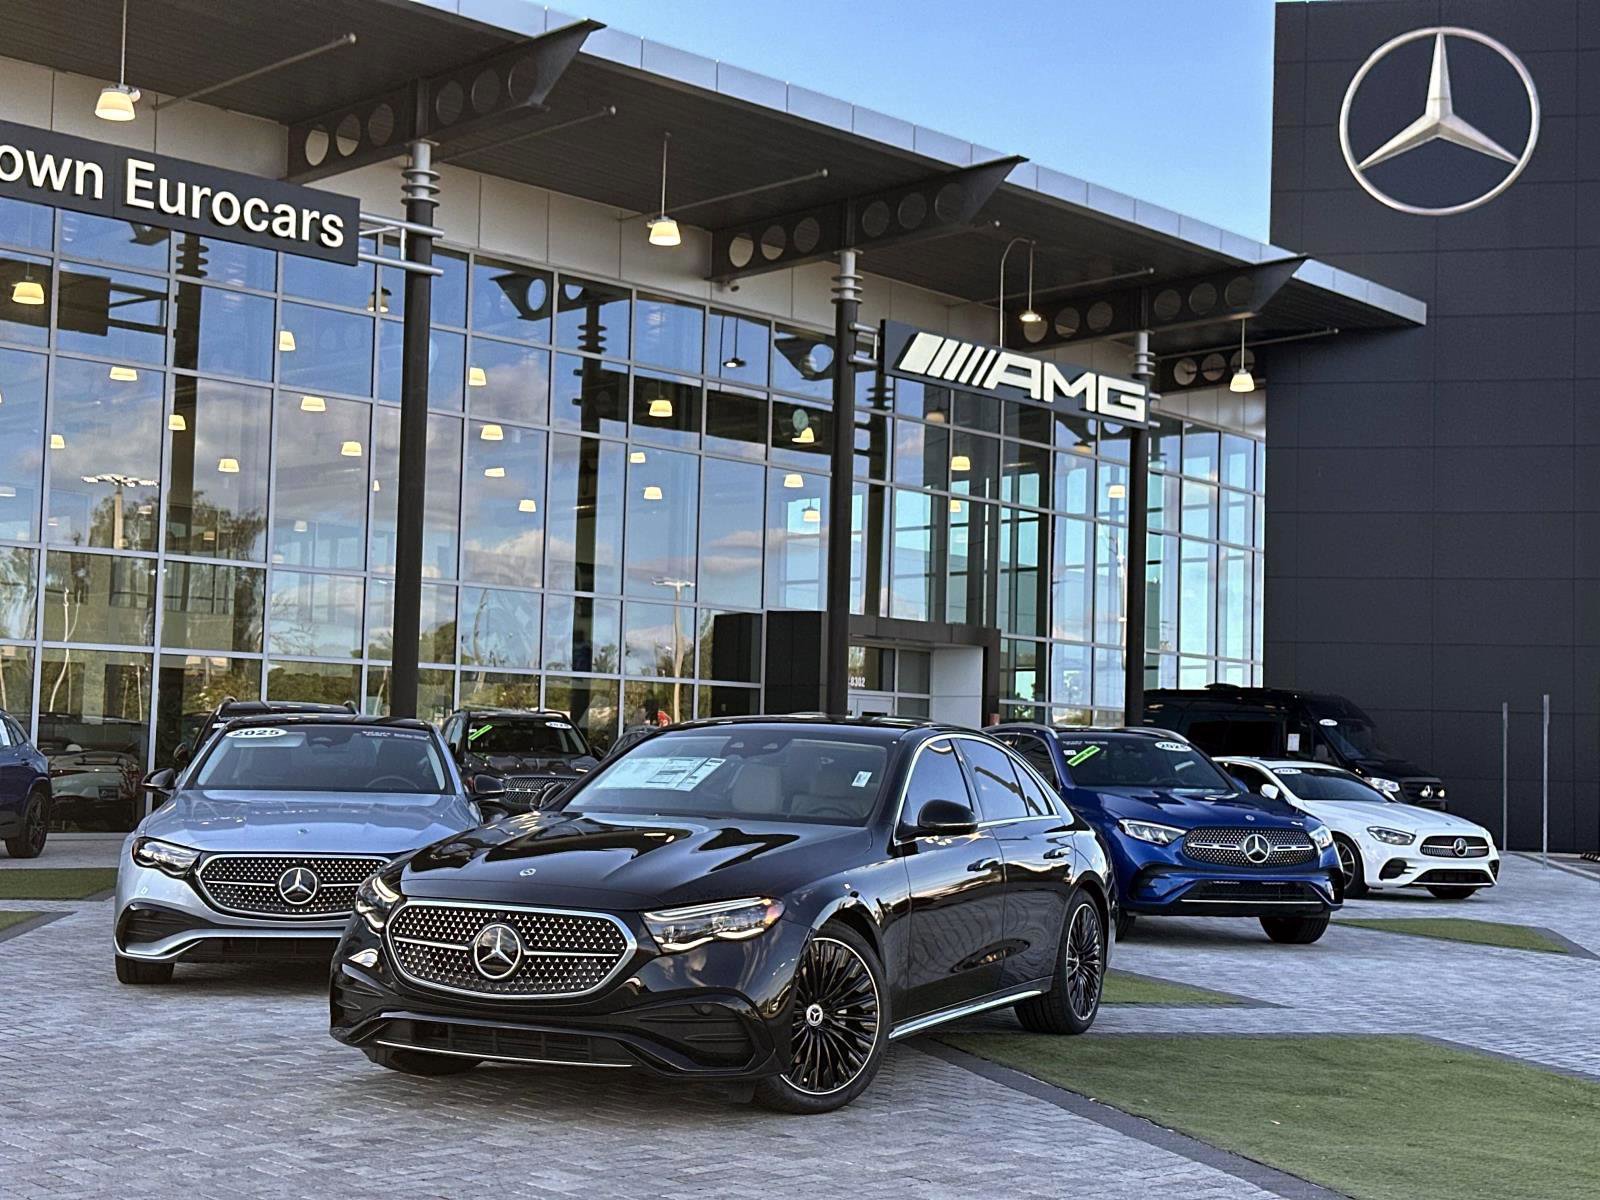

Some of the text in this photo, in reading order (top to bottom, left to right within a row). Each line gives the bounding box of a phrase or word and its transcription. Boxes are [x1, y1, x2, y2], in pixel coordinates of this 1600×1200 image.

[0, 145, 345, 248] own Eurocars
[983, 351, 1146, 422] AMG
[231, 729, 281, 737] 2025
